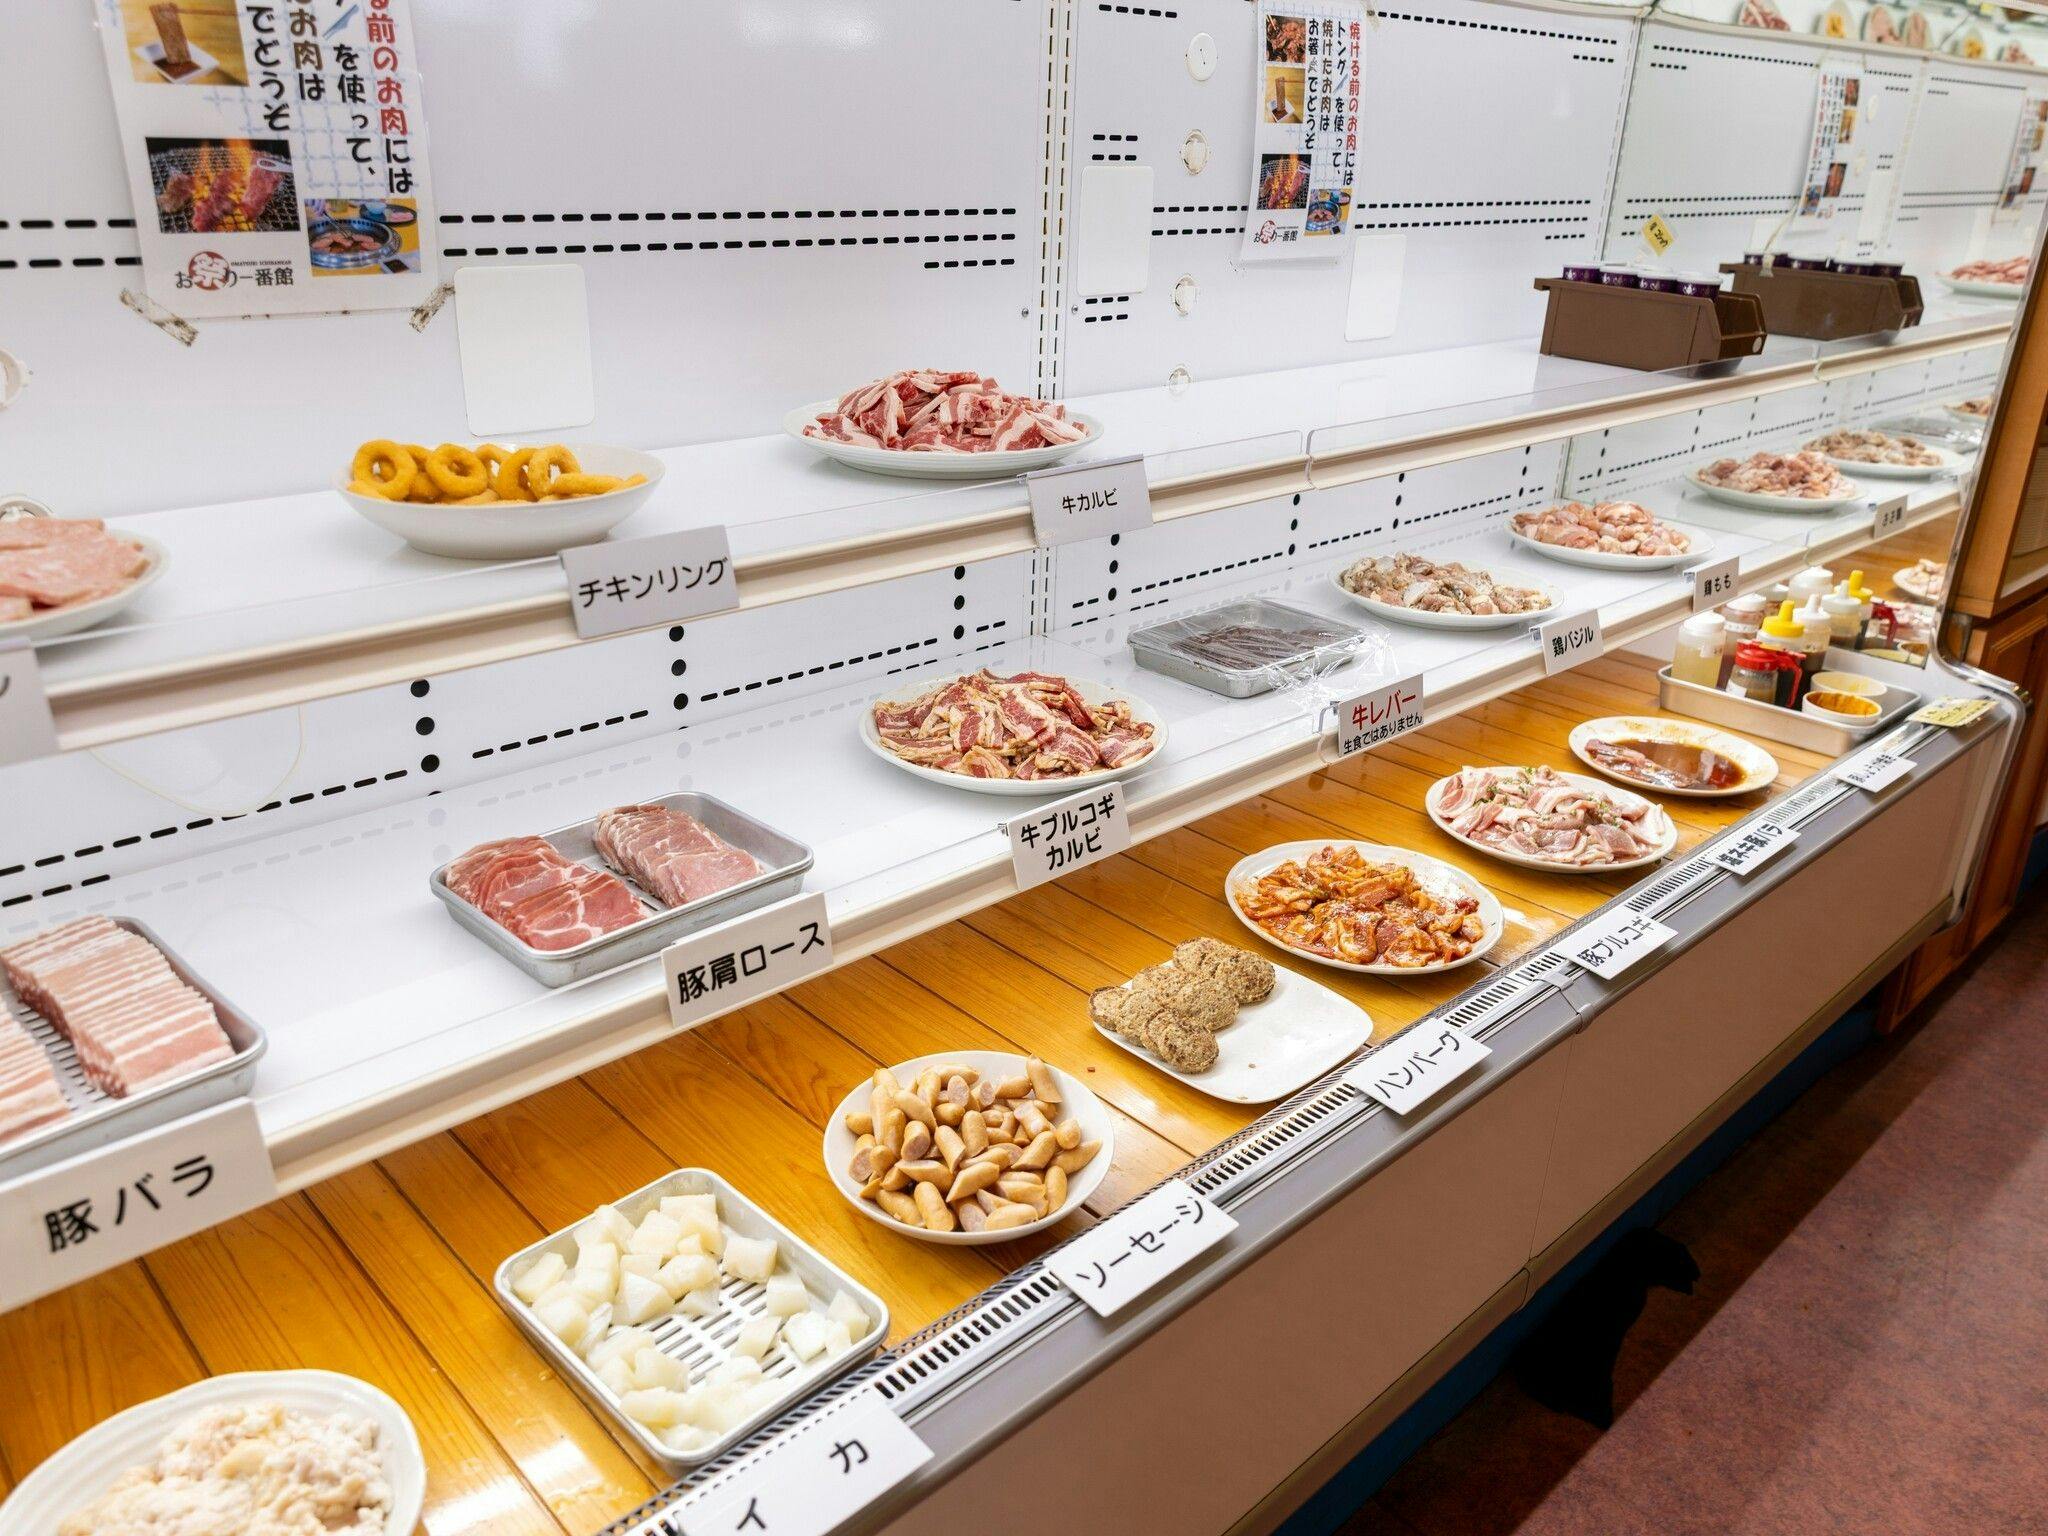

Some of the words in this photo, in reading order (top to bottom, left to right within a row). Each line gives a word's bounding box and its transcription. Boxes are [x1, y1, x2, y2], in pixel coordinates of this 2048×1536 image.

[287, 0, 325, 101] お肉は
[1319, 19, 1333, 131] 焼けたお肉は
[333, 0, 376, 176] を使って、
[1343, 21, 1360, 186] 焼ける前のお肉には
[1062, 488, 1118, 514] 牛カルビ
[578, 557, 729, 608] チキンリング
[1552, 626, 1594, 658] 鶏バジル
[1344, 712, 1423, 755] 生食ではありません
[1352, 690, 1416, 731] 牛レバー
[1021, 792, 1115, 849] 牛ブルコギ
[1046, 827, 1102, 871] カルビ
[677, 921, 825, 1005] 豚肩ロース
[1576, 916, 1655, 968] 豚ブルコギ
[1374, 1031, 1460, 1099] ハンバーグ
[44, 1154, 218, 1255] 豚バラ
[1076, 1196, 1204, 1288] ソーセージ
[736, 1439, 869, 1531] イカ
